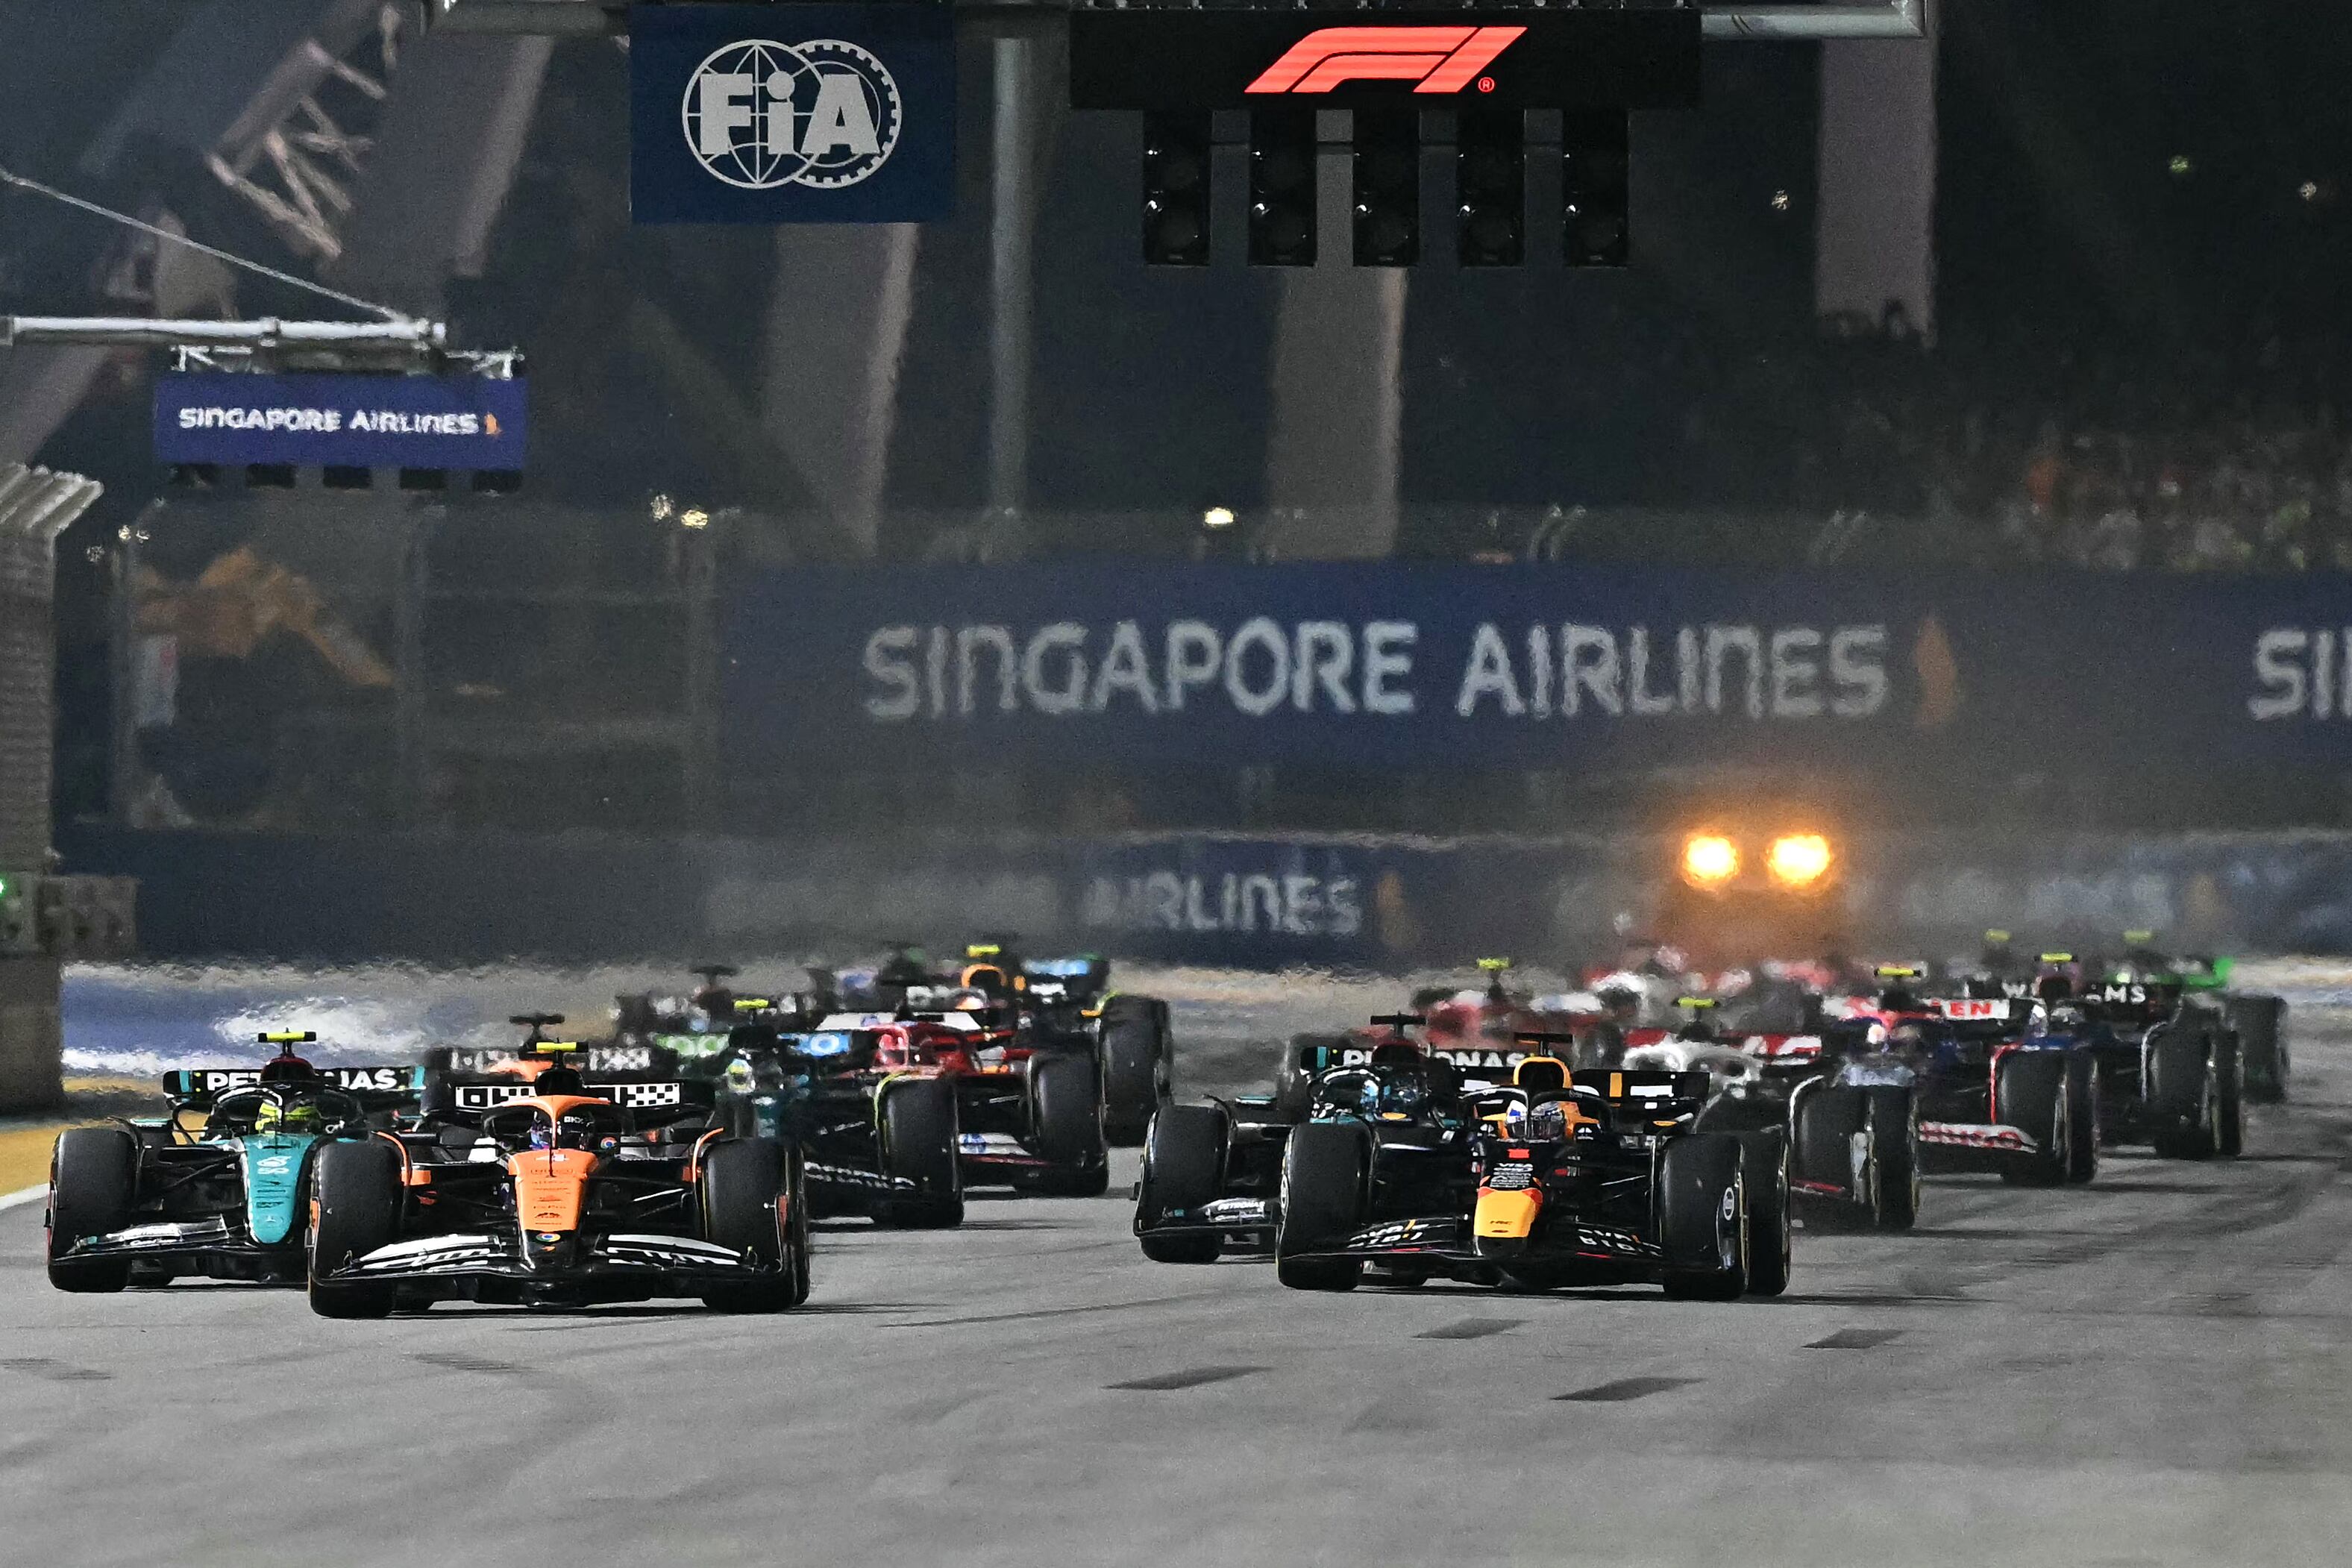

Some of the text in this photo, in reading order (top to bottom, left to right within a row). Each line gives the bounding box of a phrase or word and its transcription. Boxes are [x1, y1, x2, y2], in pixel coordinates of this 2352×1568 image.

[862, 615, 1887, 721] SINGAPORE AIRLINES
[2248, 627, 2352, 721] SI
